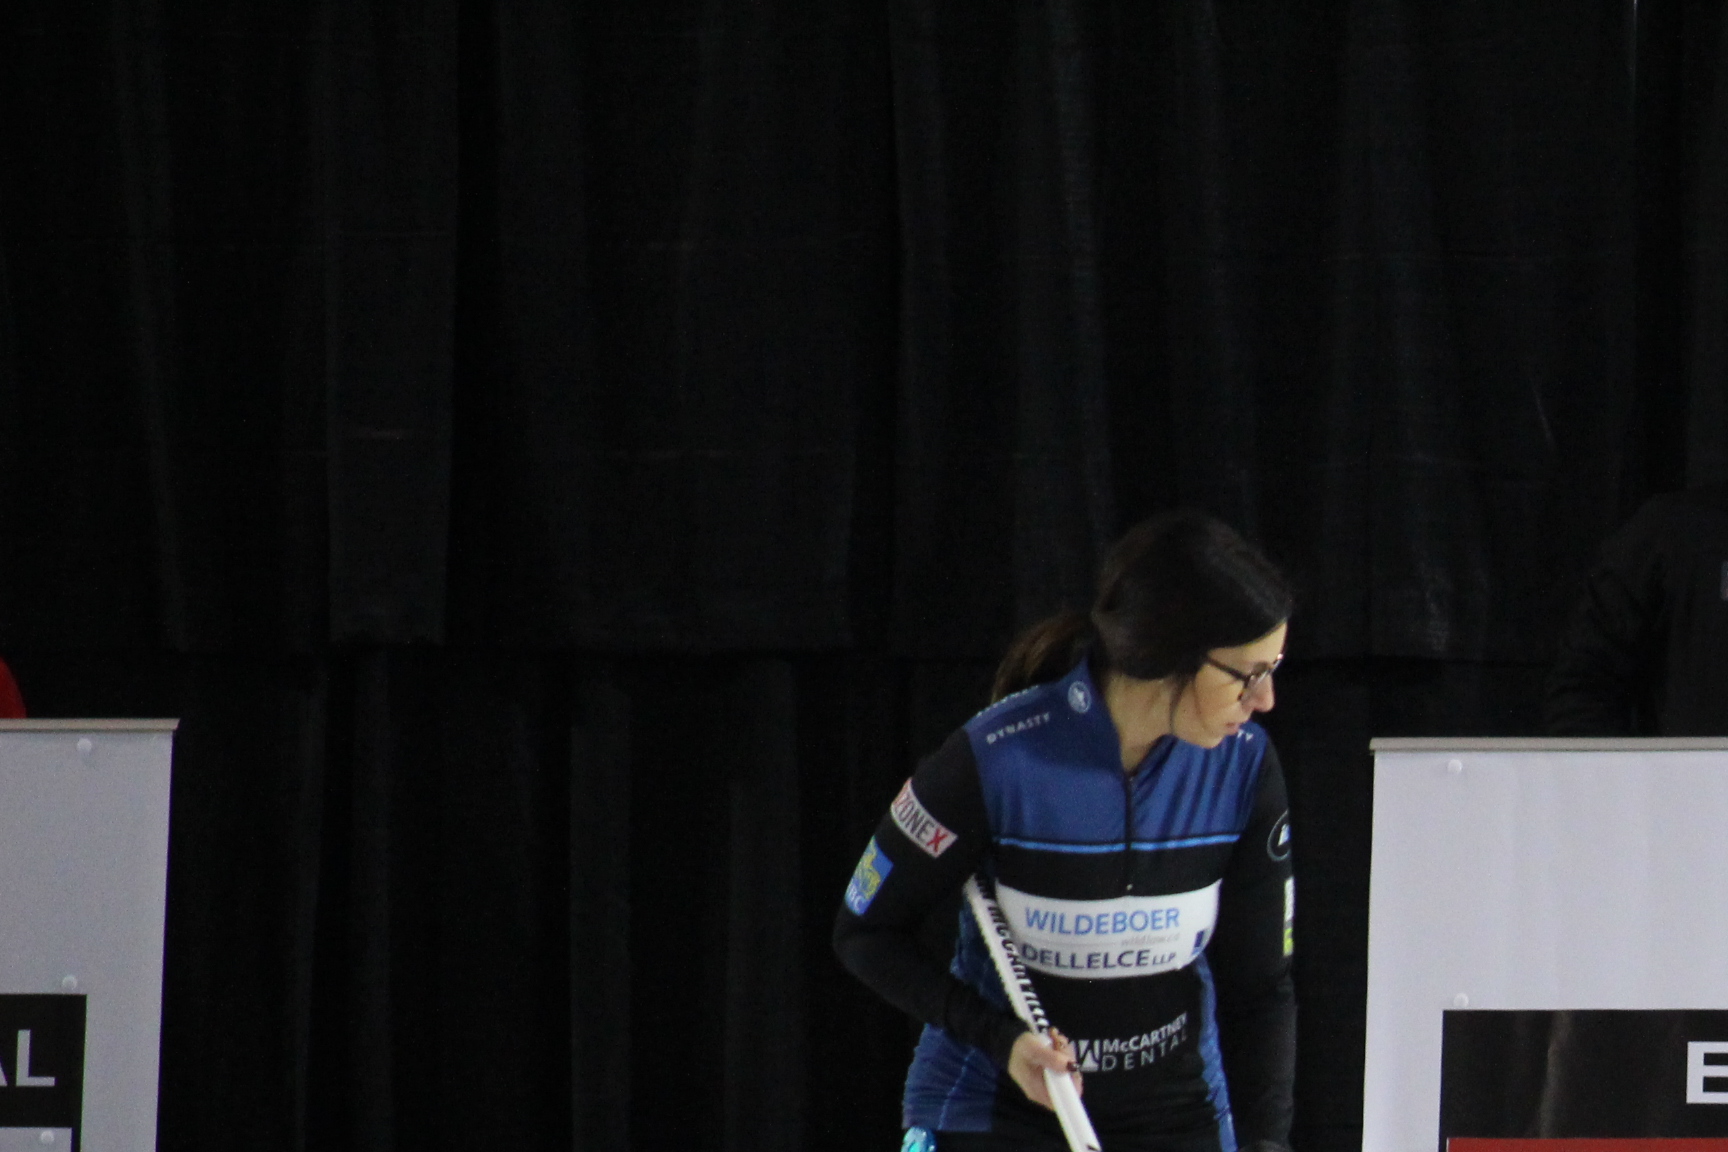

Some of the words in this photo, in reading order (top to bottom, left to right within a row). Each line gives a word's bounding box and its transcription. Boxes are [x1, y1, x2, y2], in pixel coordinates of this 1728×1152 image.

[986, 711, 1051, 745] DYNASTY
[1024, 906, 1181, 936] WILDEBOER
[1021, 949, 1151, 971] DELLELCE
[1152, 952, 1177, 966] LLP
[1101, 1012, 1188, 1053] McCARTNEY
[1101, 1032, 1188, 1072] DENTAL
